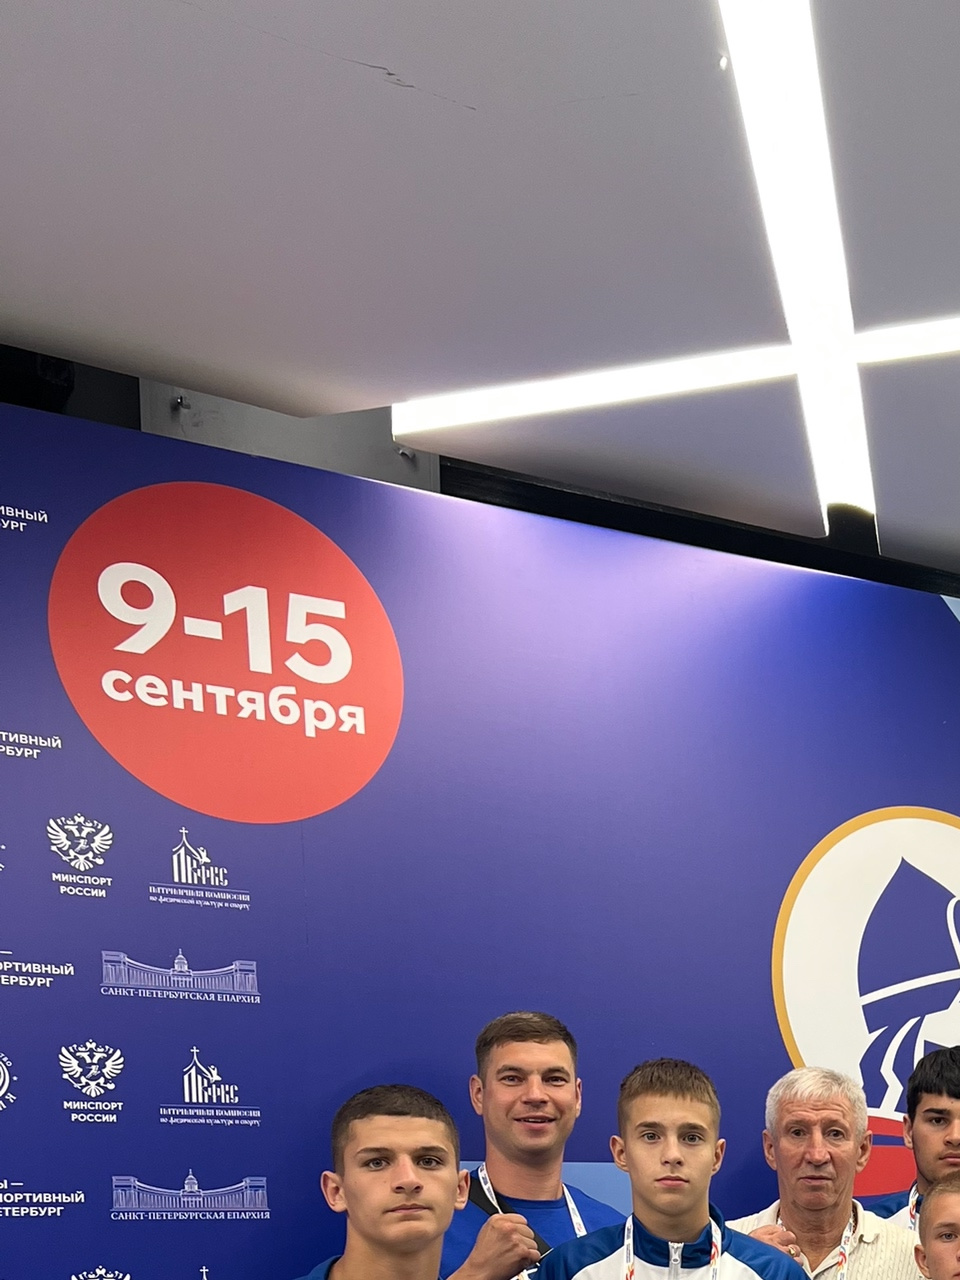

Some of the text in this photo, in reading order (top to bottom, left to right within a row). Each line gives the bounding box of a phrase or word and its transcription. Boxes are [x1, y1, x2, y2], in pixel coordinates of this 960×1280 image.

[97, 561, 353, 684] 9-15
[101, 669, 366, 738] сентября
[52, 872, 113, 887] МИНСПОРТ
[60, 885, 107, 898] РОССИИ
[100, 986, 261, 1004] САНКТ-ПЕТЕРБУРГСКАЯ ЕПАРХИЯ
[63, 1100, 124, 1111] МИНСПОРТ
[71, 1113, 117, 1123] РОССИИ
[0, 1190, 85, 1203] ОРТИВНЫЙ
[0, 1206, 64, 1217] ТЕРБУРГ
[110, 1210, 270, 1221] САНКТ-ПЕТЕРБУРГСКАЯ ЕПАРХИЯ
